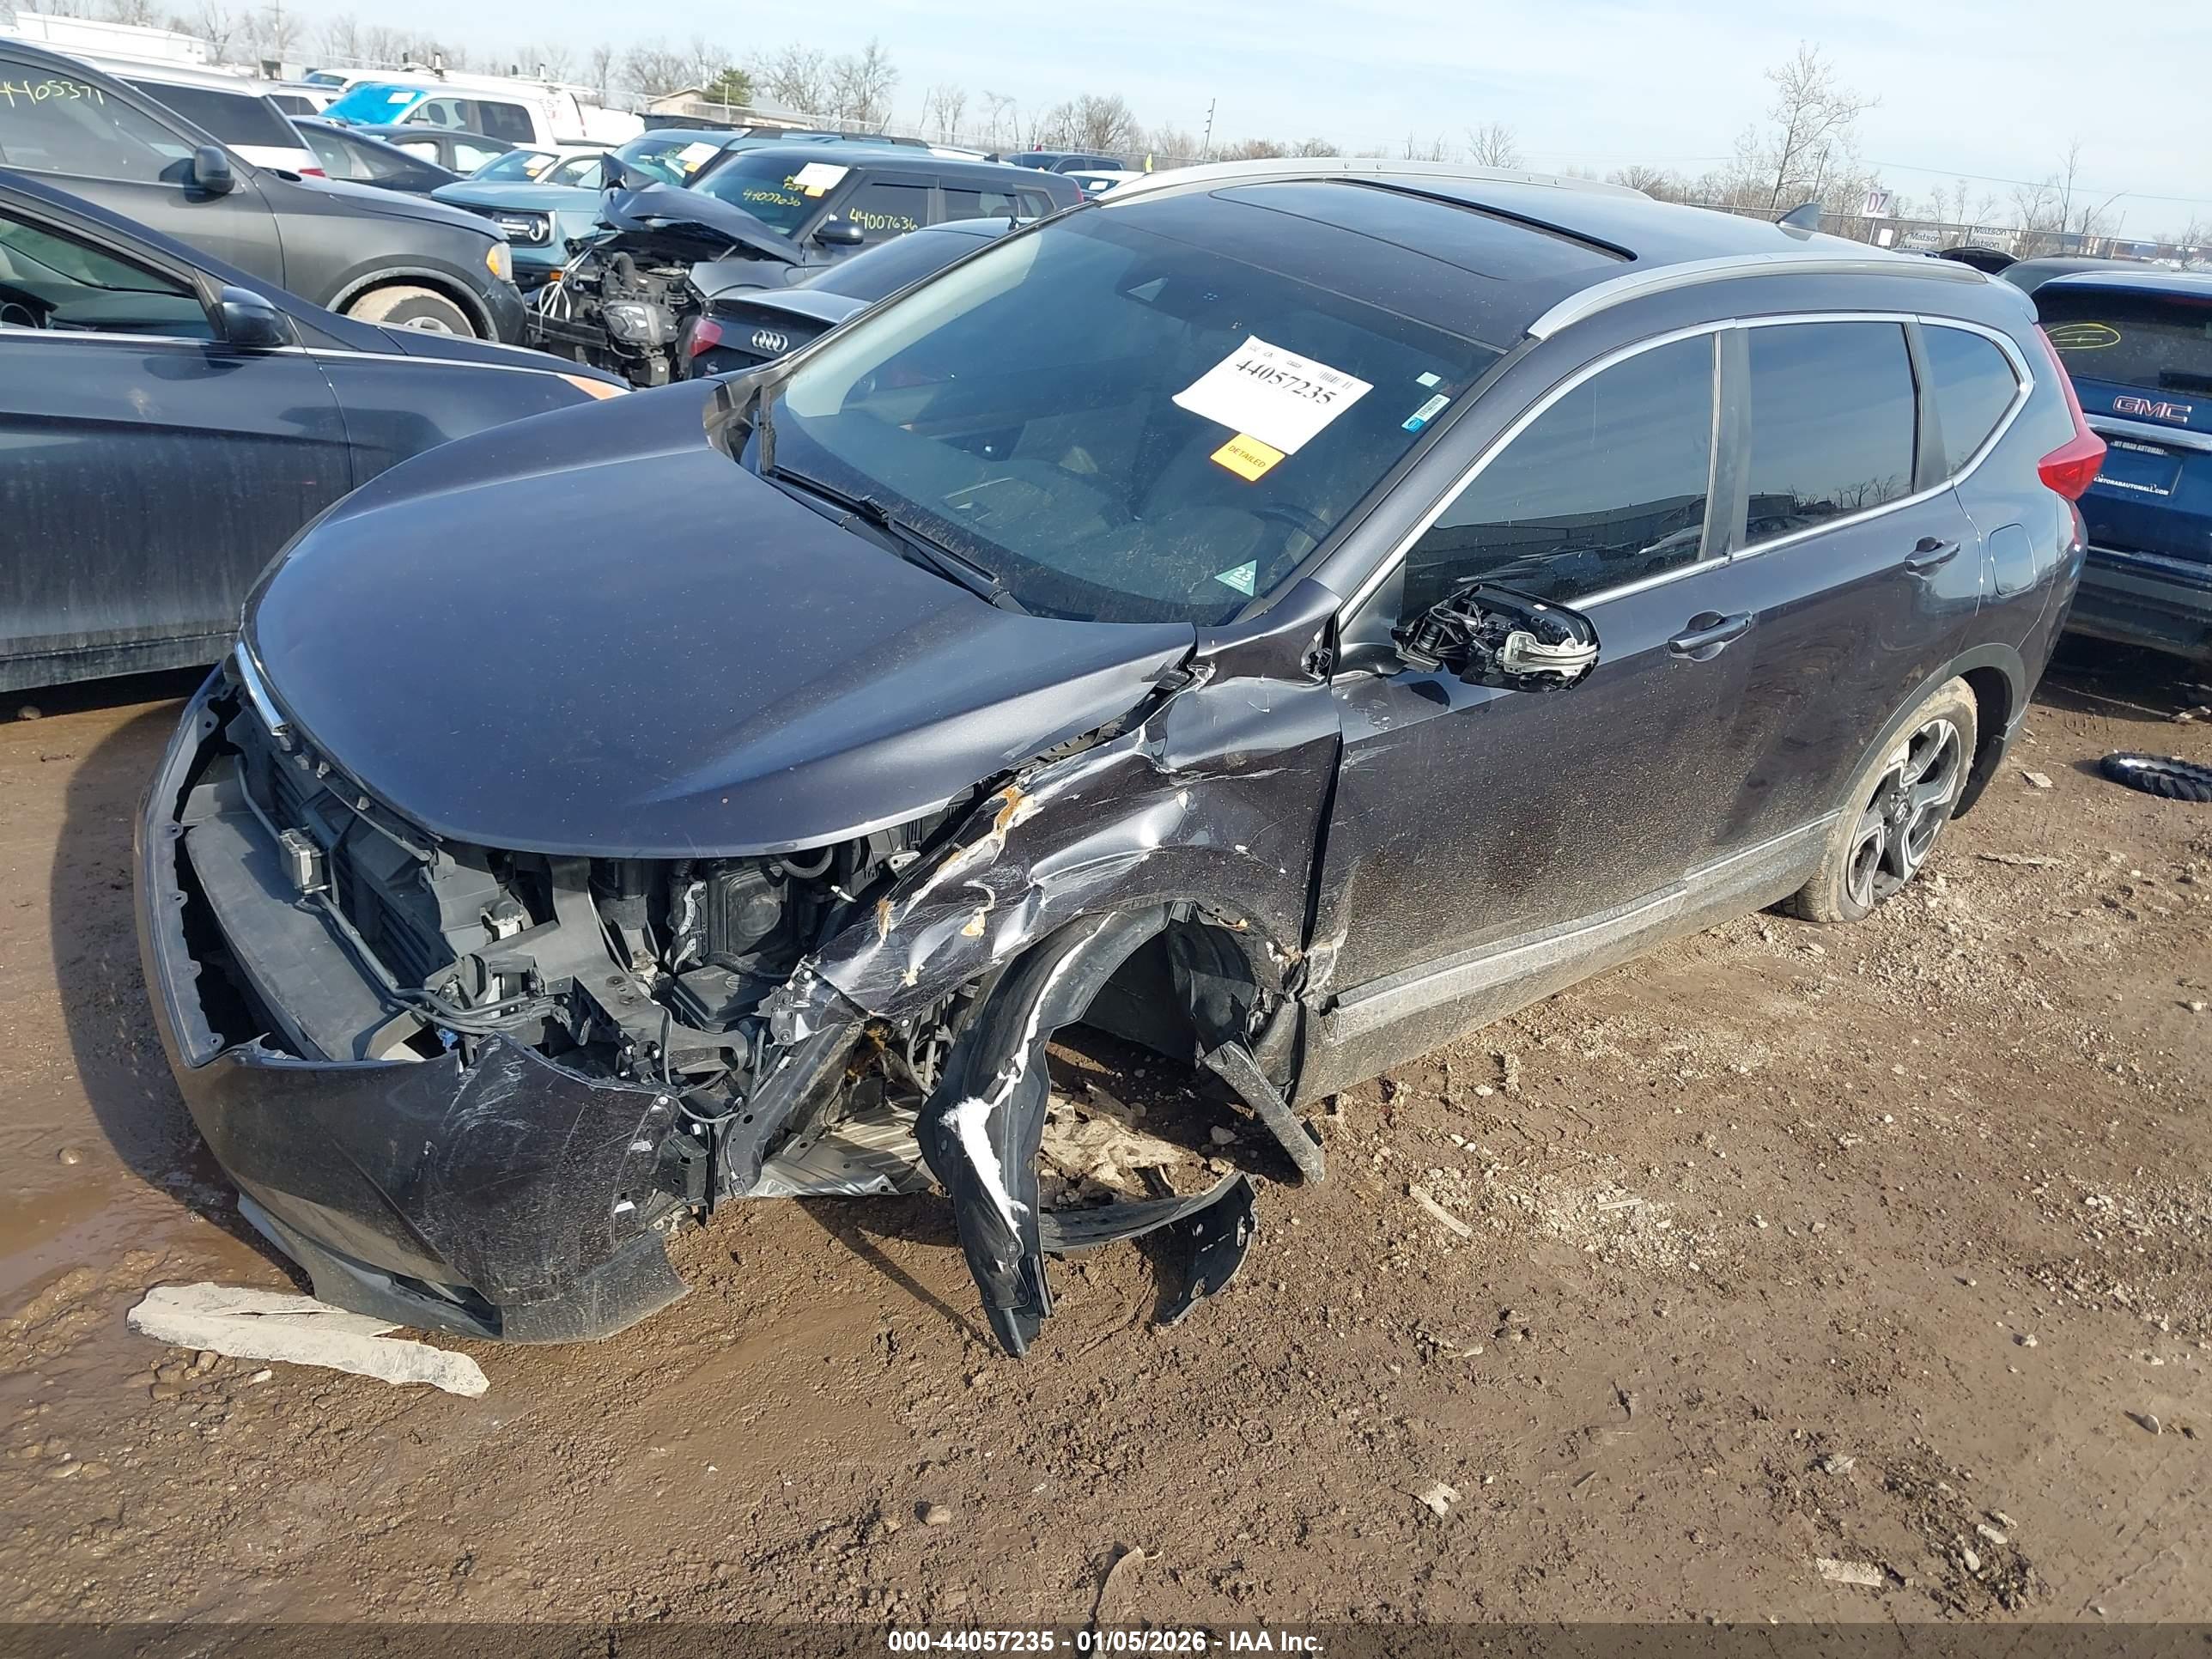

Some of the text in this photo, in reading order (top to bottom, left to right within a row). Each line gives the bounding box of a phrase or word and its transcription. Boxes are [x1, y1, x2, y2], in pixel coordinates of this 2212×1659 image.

[1867, 192, 1889, 213] DZ
[849, 207, 918, 231] 44007636
[1910, 233, 1940, 243] Matson
[1969, 239, 1999, 249] Matson
[1236, 360, 1337, 404] 44057235
[2113, 396, 2192, 423] GMC
[1228, 446, 1267, 468] DETAILED
[1233, 567, 1255, 581] 23
